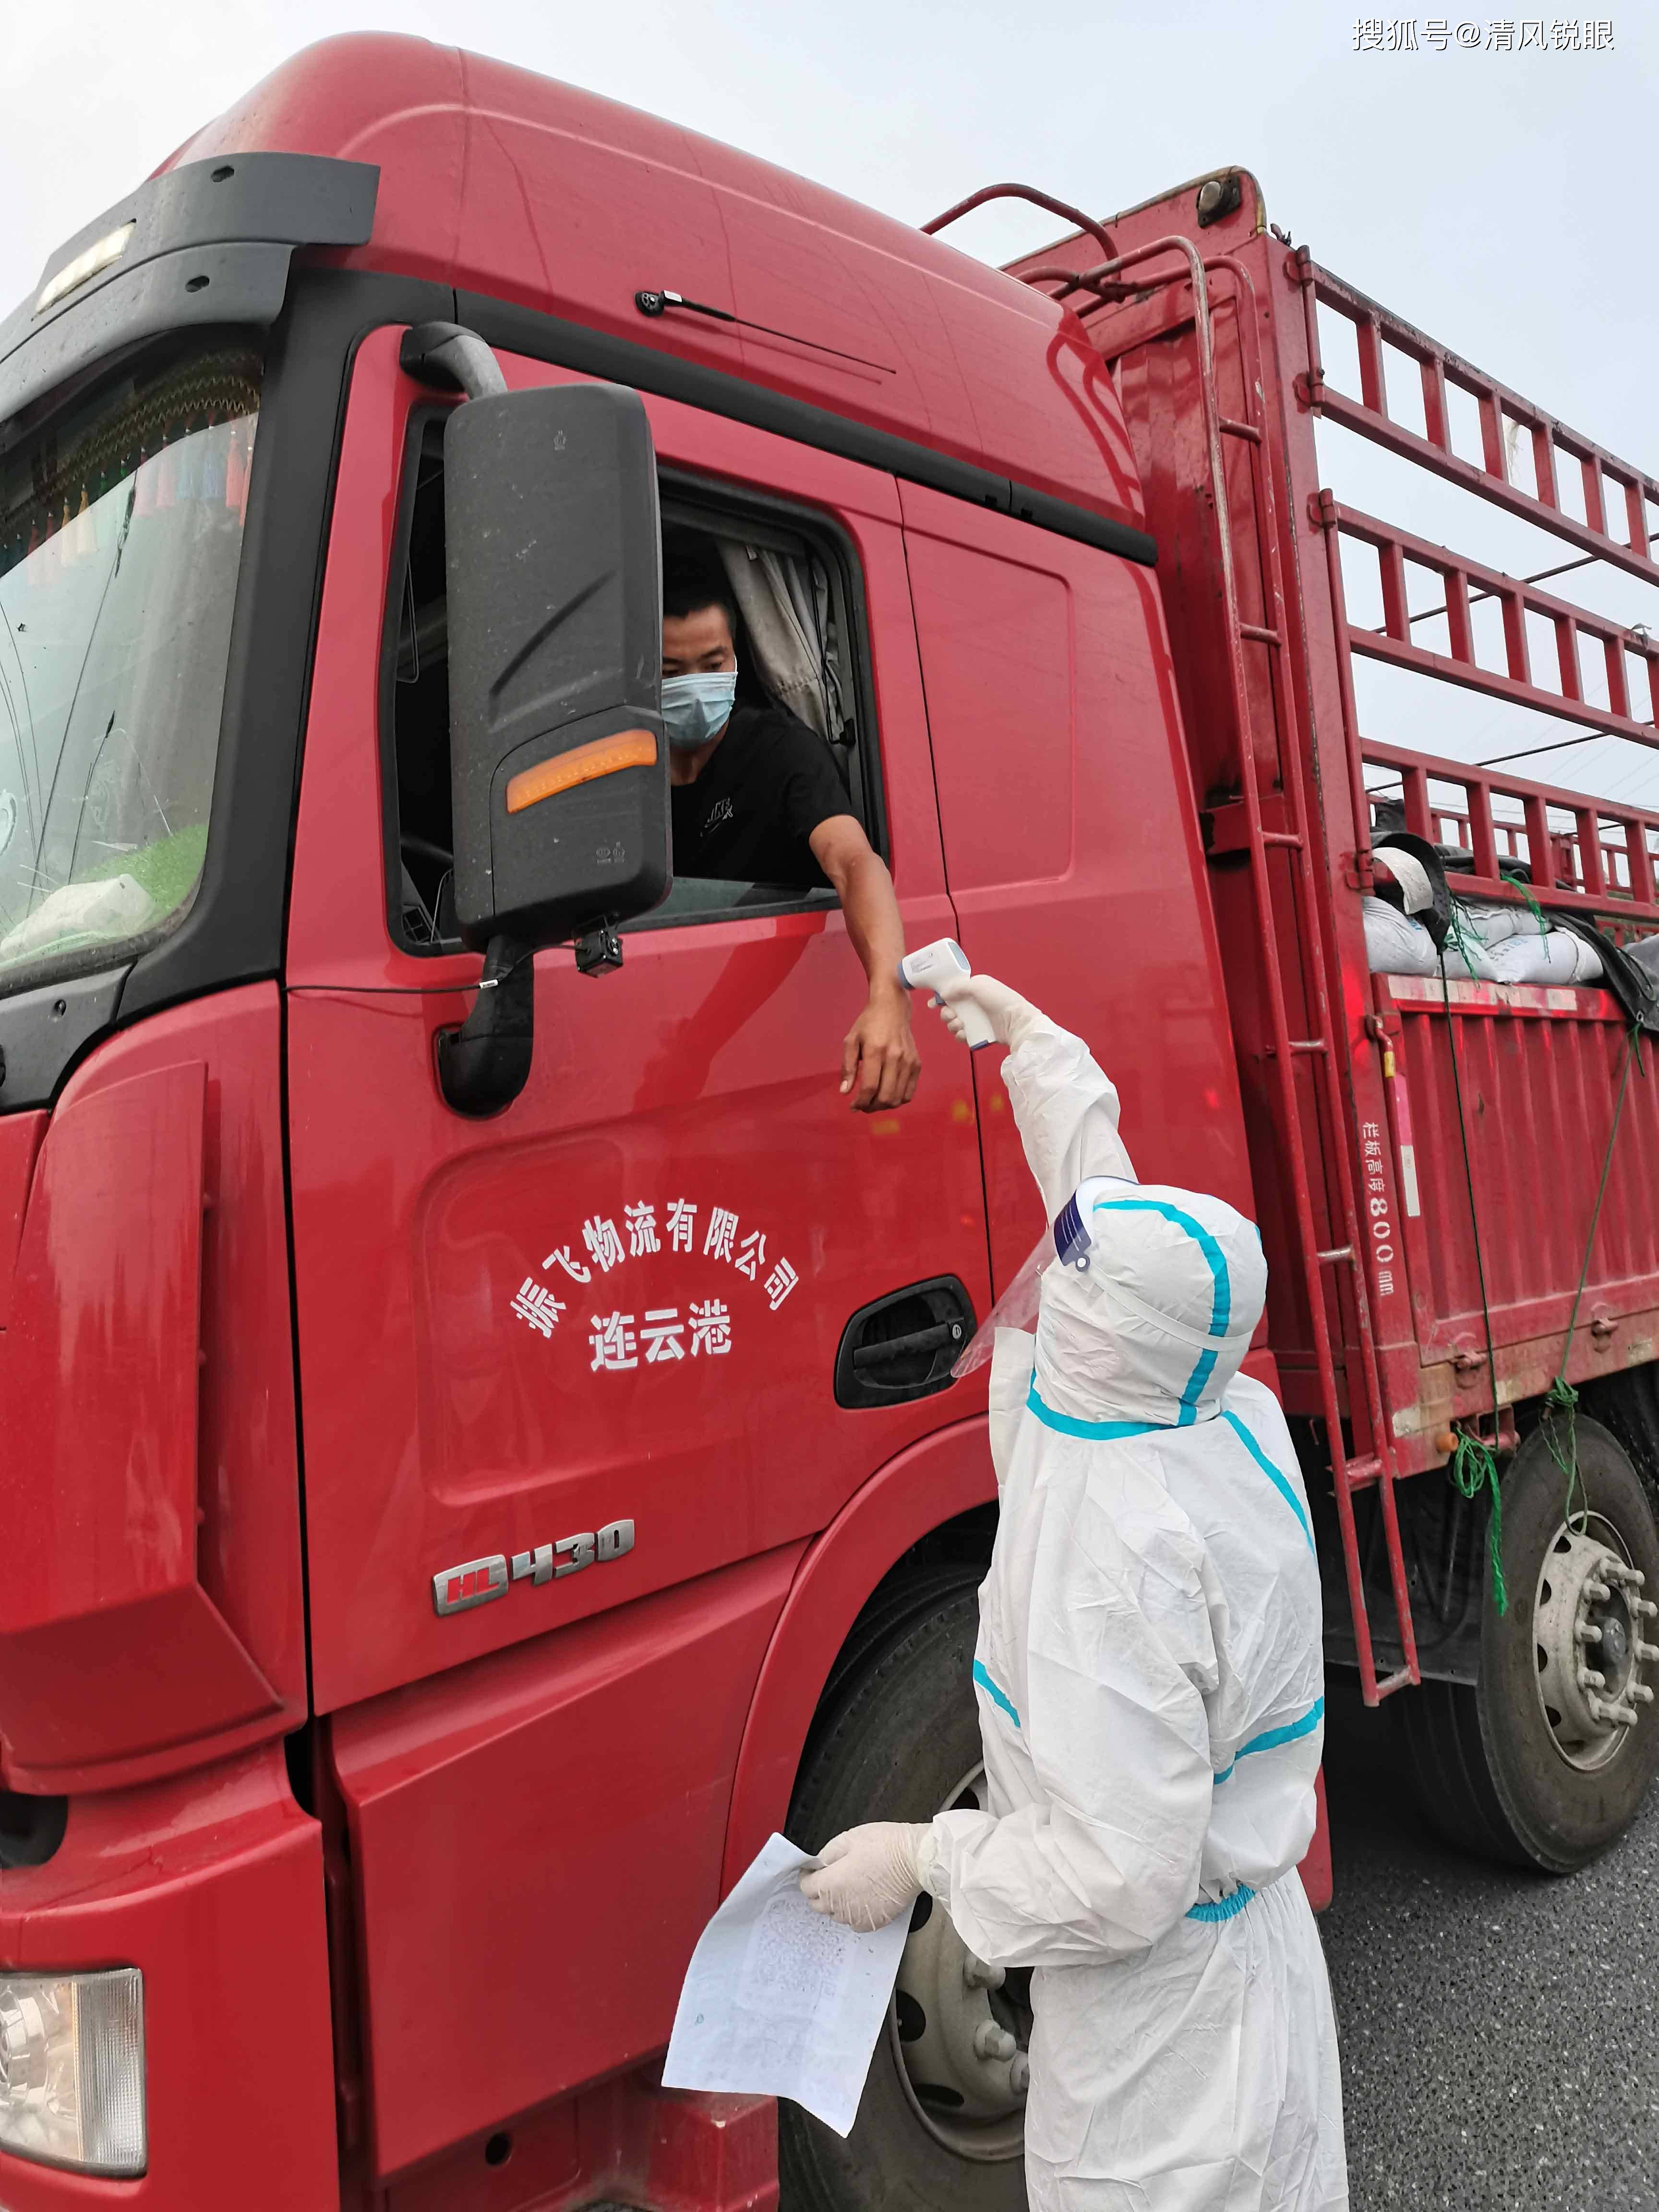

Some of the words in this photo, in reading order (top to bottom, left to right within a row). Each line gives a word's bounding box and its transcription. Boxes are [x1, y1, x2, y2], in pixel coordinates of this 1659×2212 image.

[510, 1198, 799, 1338] 振飞物流有限公司
[589, 1298, 732, 1371] 连云港
